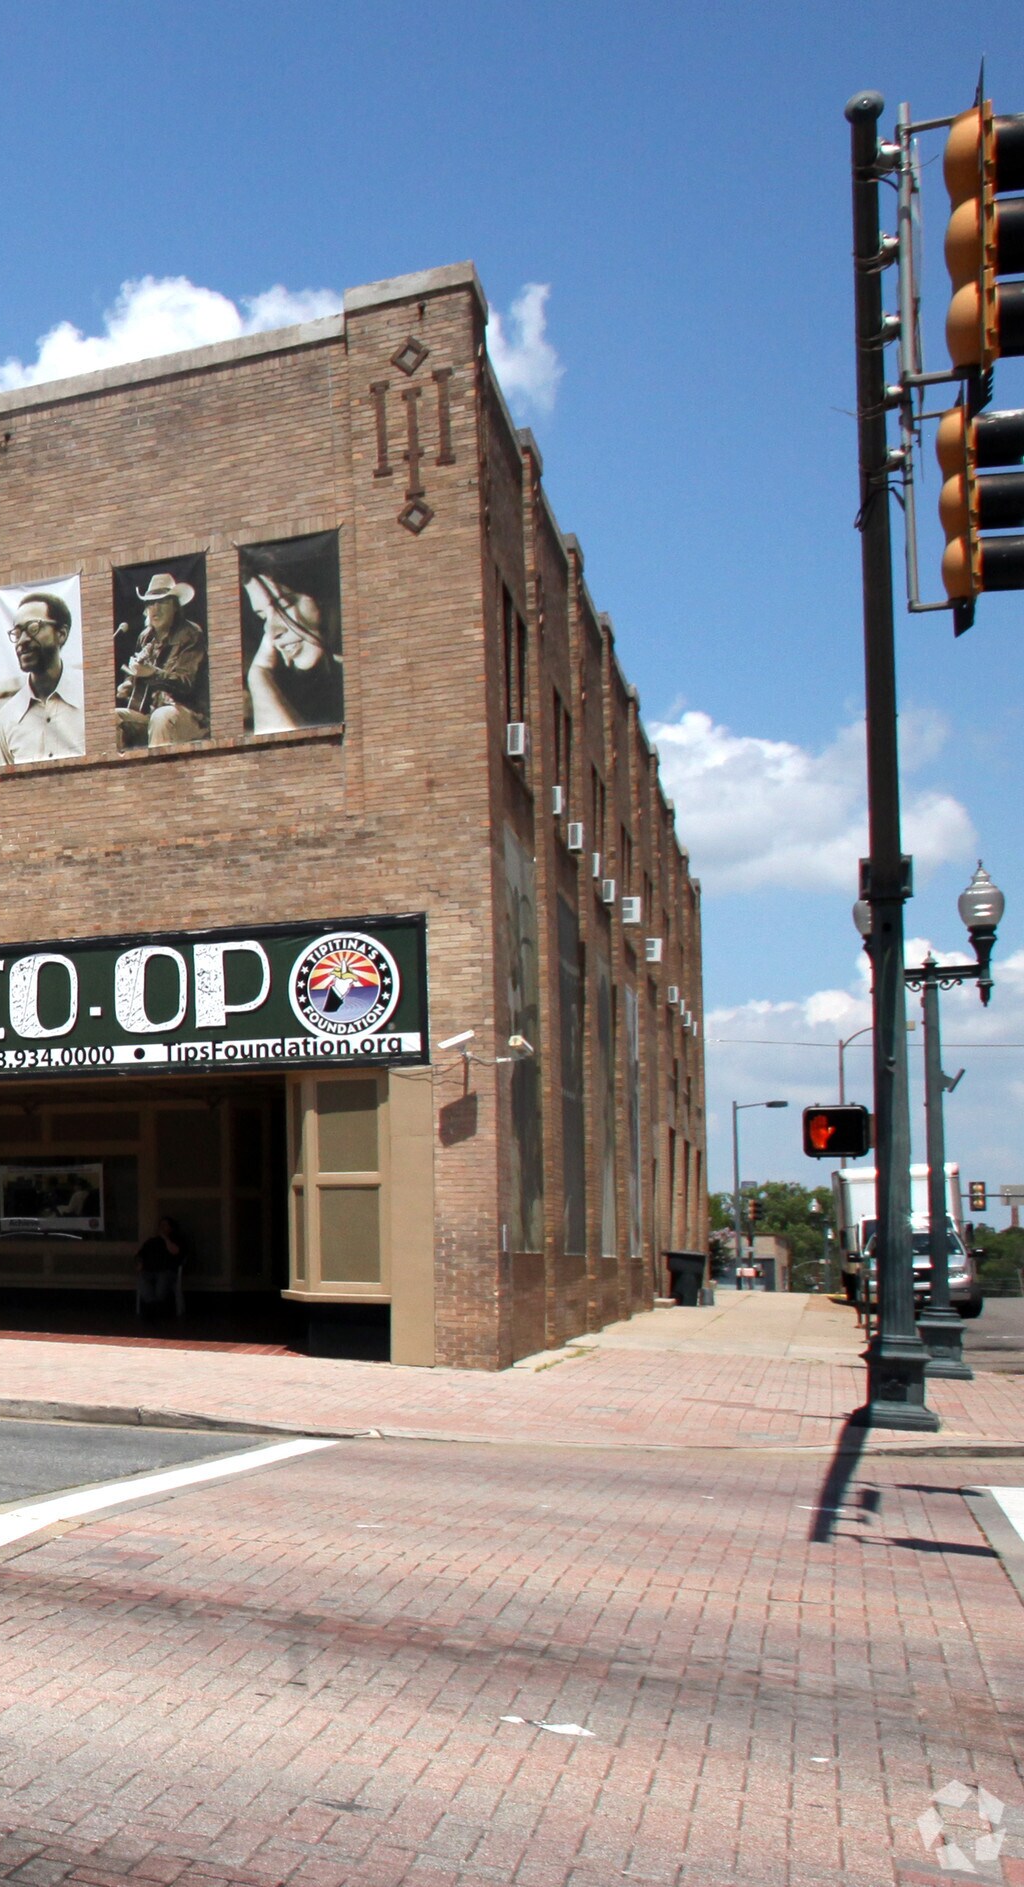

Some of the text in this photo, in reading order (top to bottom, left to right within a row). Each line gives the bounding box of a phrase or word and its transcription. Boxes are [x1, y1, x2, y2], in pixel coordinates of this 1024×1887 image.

[307, 939, 378, 963] TIPITINA'S
[303, 1003, 385, 1034] FOUNDATION
[162, 1036, 403, 1064] TipsFoundation.org
